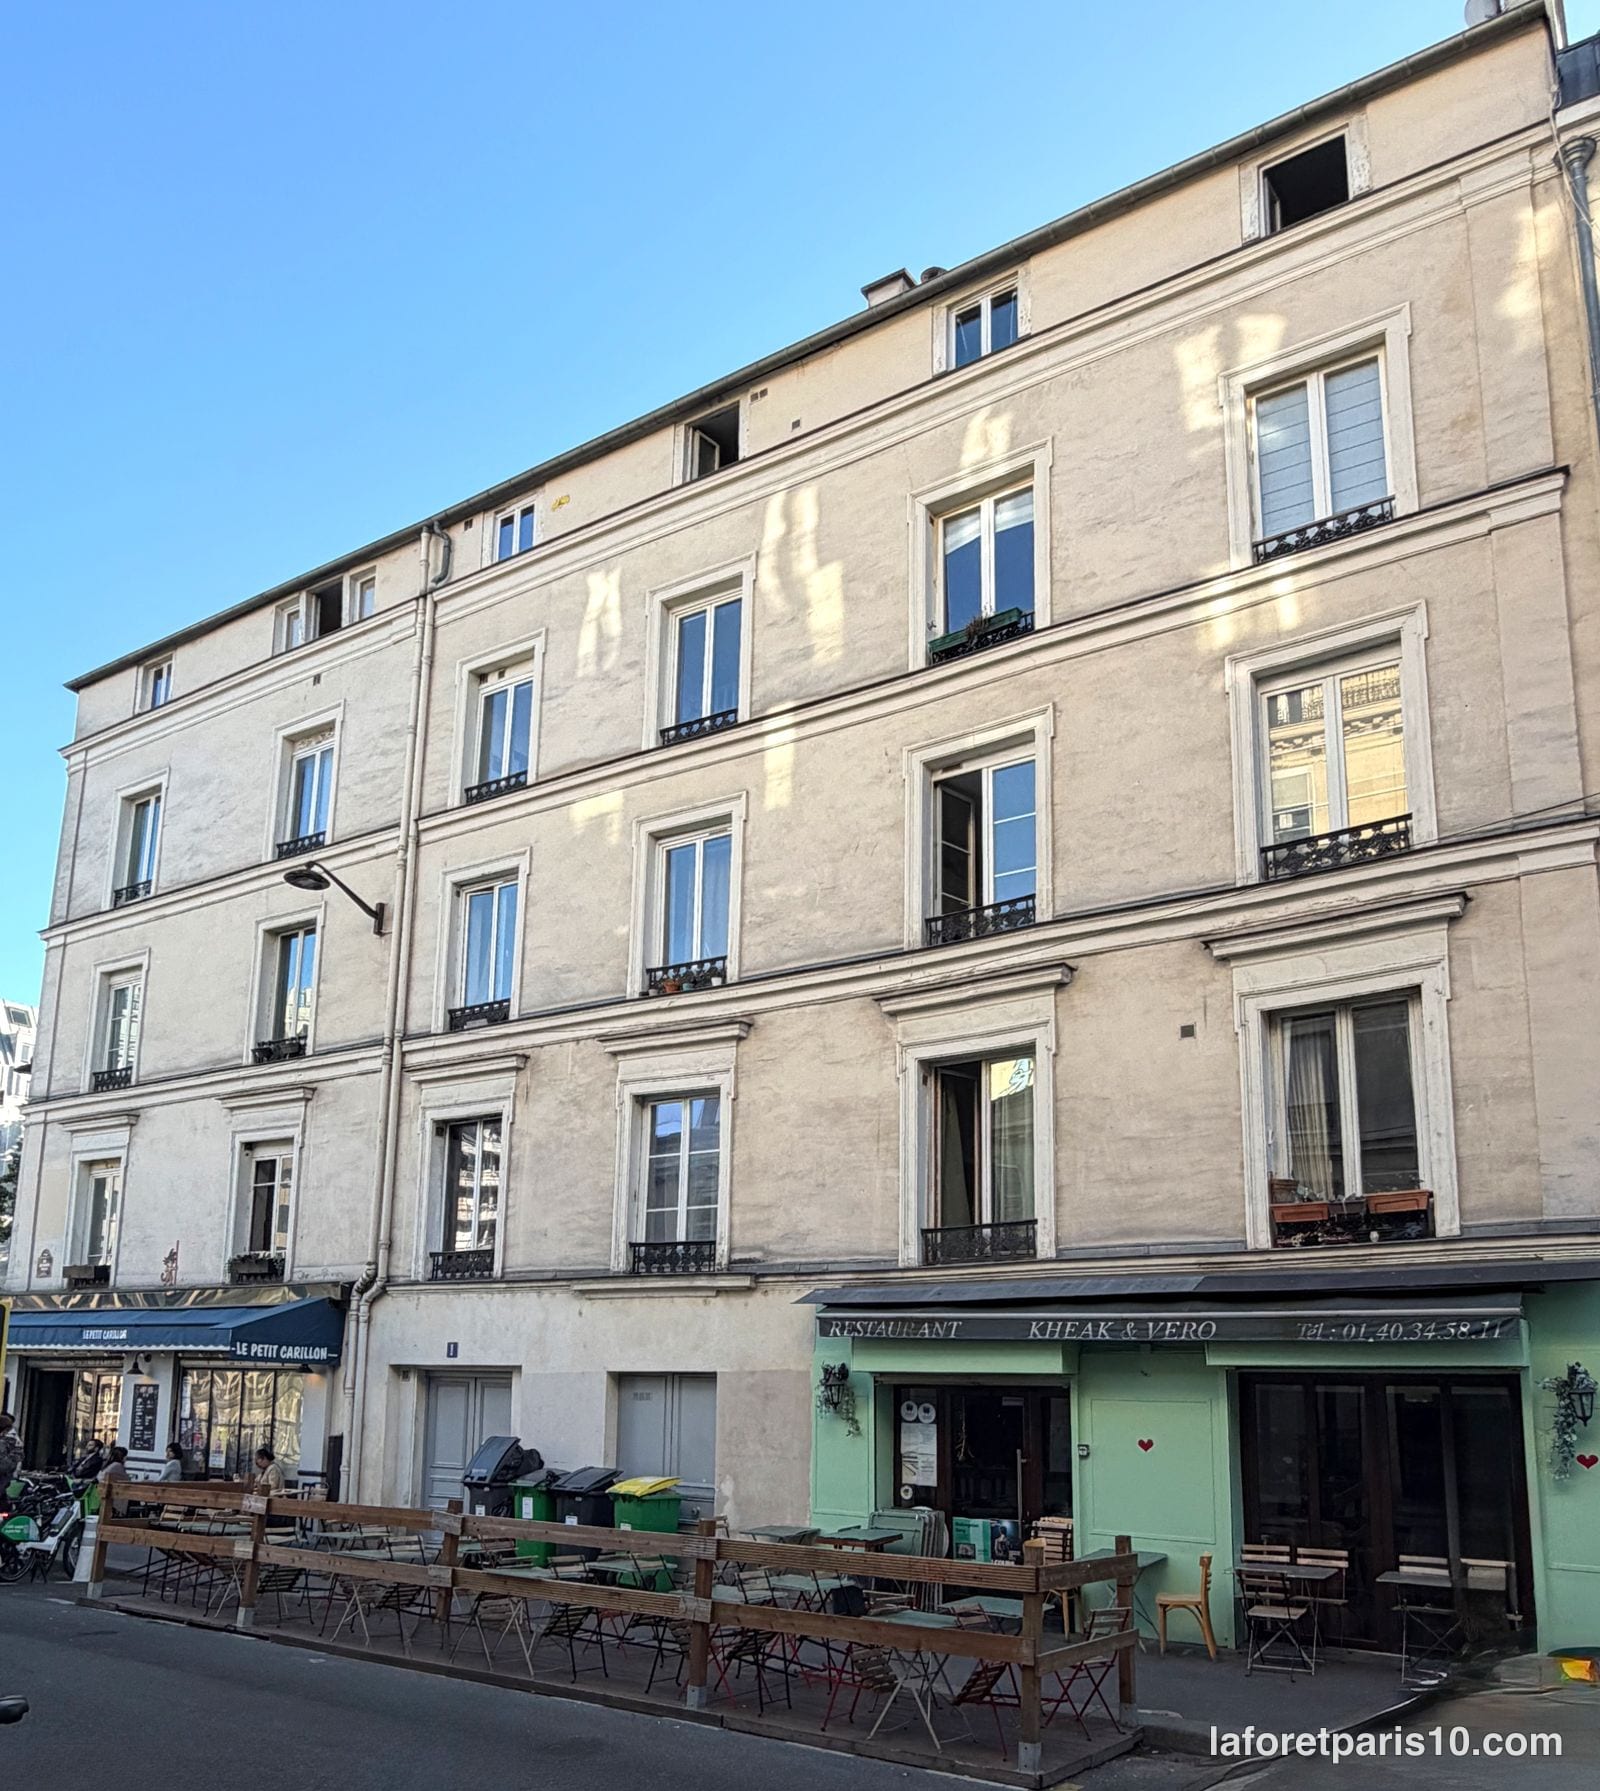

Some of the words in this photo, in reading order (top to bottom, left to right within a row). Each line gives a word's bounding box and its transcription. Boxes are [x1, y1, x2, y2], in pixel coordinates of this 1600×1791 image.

[829, 1320, 962, 1338] RESTAURANT
[1028, 1321, 1115, 1340] KHEAK
[1120, 1321, 1138, 1340] &
[1146, 1321, 1217, 1340] VERO
[236, 1341, 248, 1355] LE
[250, 1343, 279, 1358] PETIT
[280, 1346, 328, 1360] CARILLON
